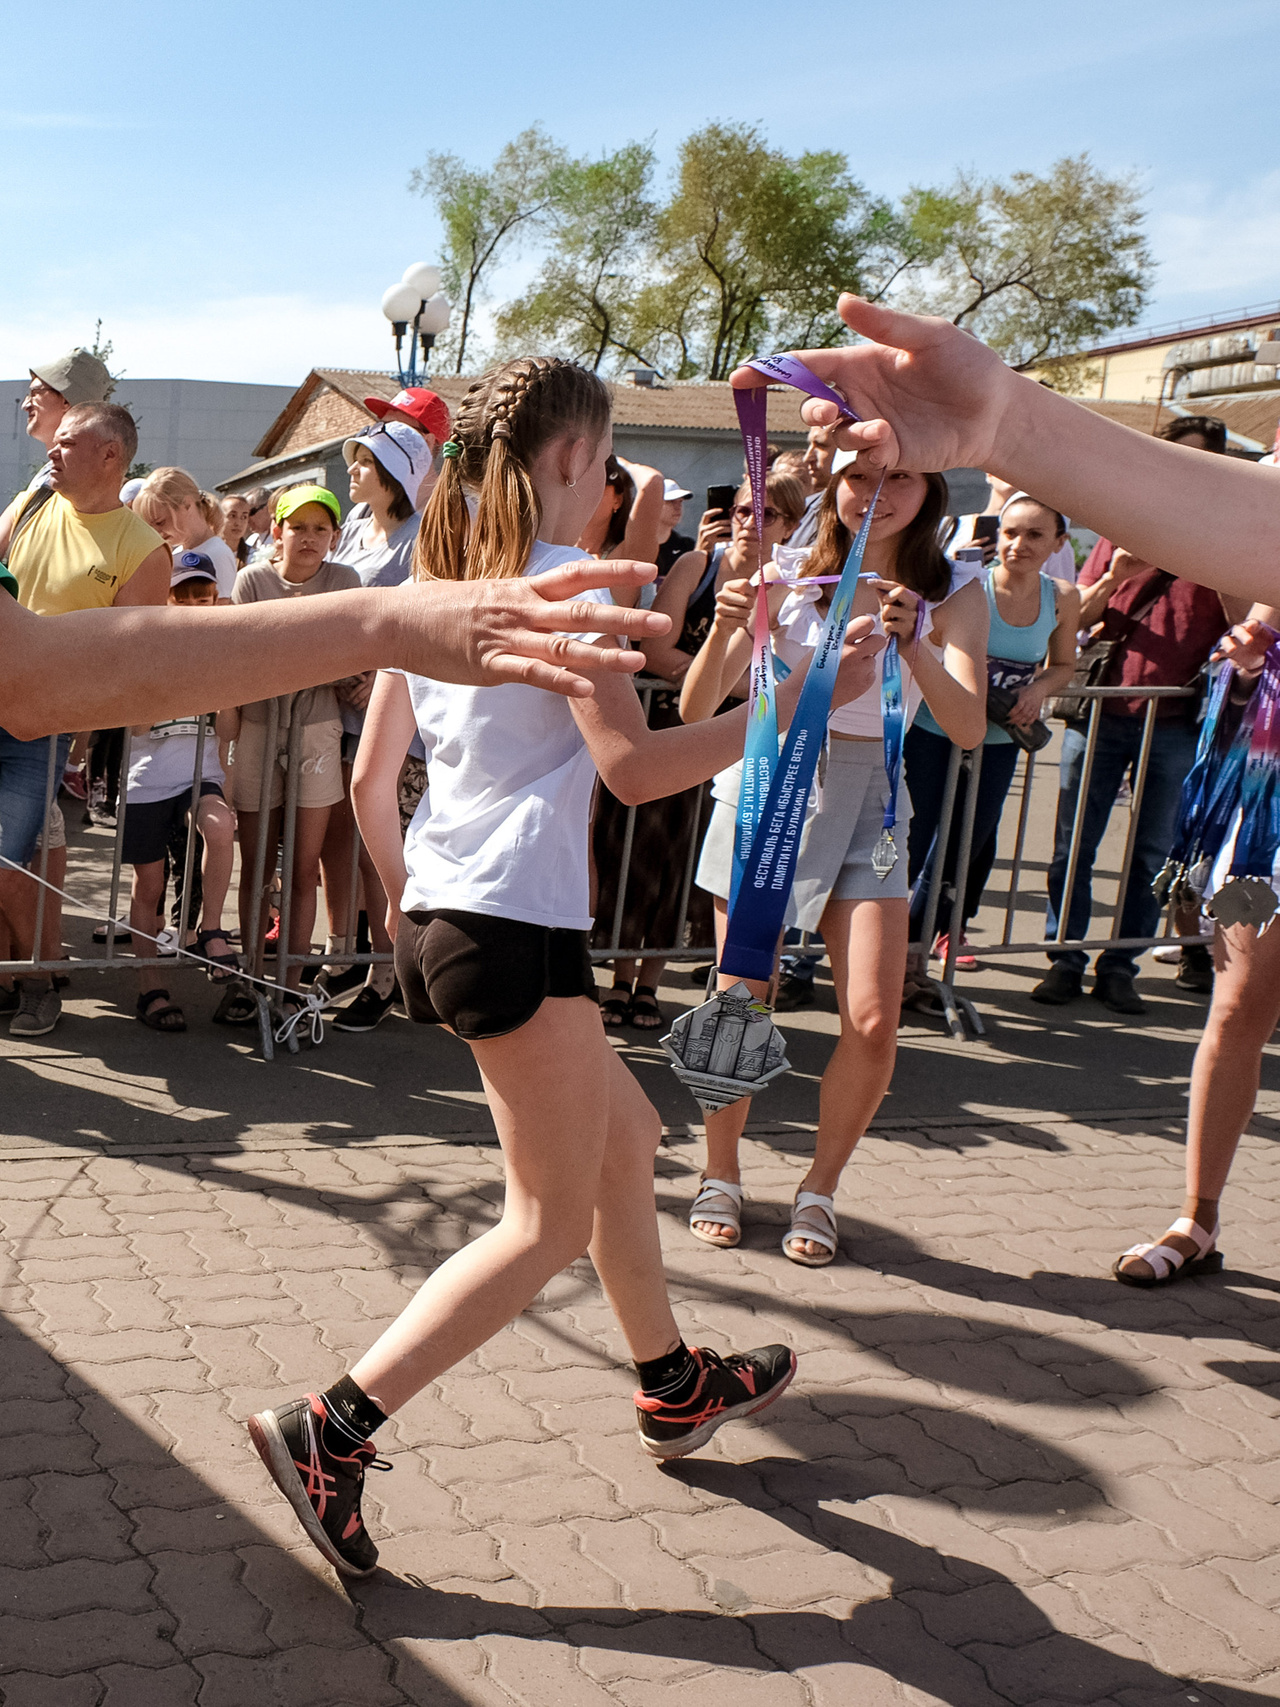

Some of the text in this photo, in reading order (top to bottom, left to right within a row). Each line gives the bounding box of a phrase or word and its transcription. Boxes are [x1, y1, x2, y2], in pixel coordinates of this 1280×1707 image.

[744, 757, 755, 794] ПАМЯТИ
[753, 729, 809, 889] ФЕСТИВАЛЬ БЕГА «БЫСТРЕЕ ВЕТРА»
[771, 852, 791, 890] ПАМЯТИ
